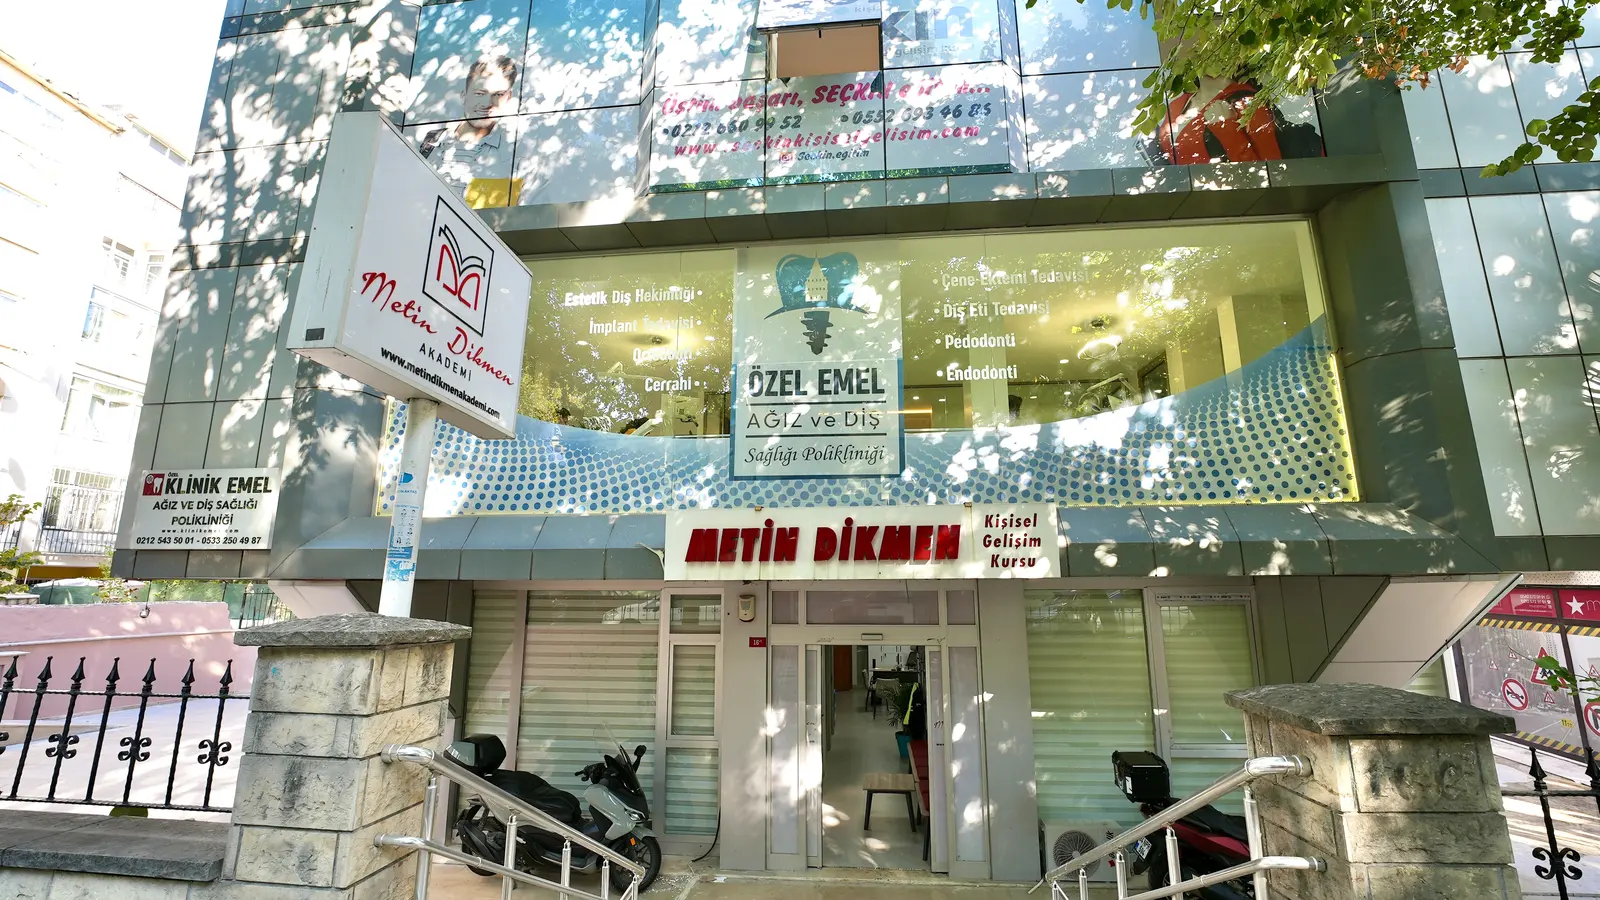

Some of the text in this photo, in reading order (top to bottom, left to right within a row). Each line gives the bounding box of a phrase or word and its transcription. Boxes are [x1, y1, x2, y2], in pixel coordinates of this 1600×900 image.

[852, 109, 896, 125] 0552
[901, 106, 935, 122] 693
[940, 104, 963, 119] 46
[671, 122, 712, 138] 0212
[754, 117, 776, 132] 99
[779, 115, 802, 130] 52
[564, 290, 608, 307] Estetik
[612, 289, 632, 306] Diş
[944, 300, 1050, 320] Diş Eti Tedavisi
[360, 271, 515, 386] Metin Dikmen
[589, 317, 638, 336] İmplant
[945, 333, 1016, 349] Pedodonti
[749, 365, 885, 397] ÖZEL EMEL
[946, 365, 1018, 381] Endodonti
[380, 346, 501, 420] www.metindikmenakademi.com
[644, 376, 692, 392] Cerrahi
[746, 408, 880, 430] AĞIZ ve DİŞ
[744, 443, 886, 467] Sağlığı Polikliniği
[165, 474, 272, 495] KLİNİK EMEL
[153, 498, 258, 512] AĞIZ VE DİŞ SAĞLIĞI
[171, 514, 234, 526] POLİKLİNİĞİ
[984, 513, 1038, 529] Kişisel
[136, 537, 155, 545] 0212
[157, 537, 172, 545] 543
[173, 537, 184, 545] 50
[185, 537, 195, 545] 01
[201, 537, 221, 545] 0533
[222, 537, 238, 545] 250
[239, 537, 250, 545] 49
[251, 537, 262, 545] 87
[685, 517, 961, 562] METİN DİKMEN
[982, 534, 1043, 550] Gelişim
[990, 554, 1036, 569] Kursu
